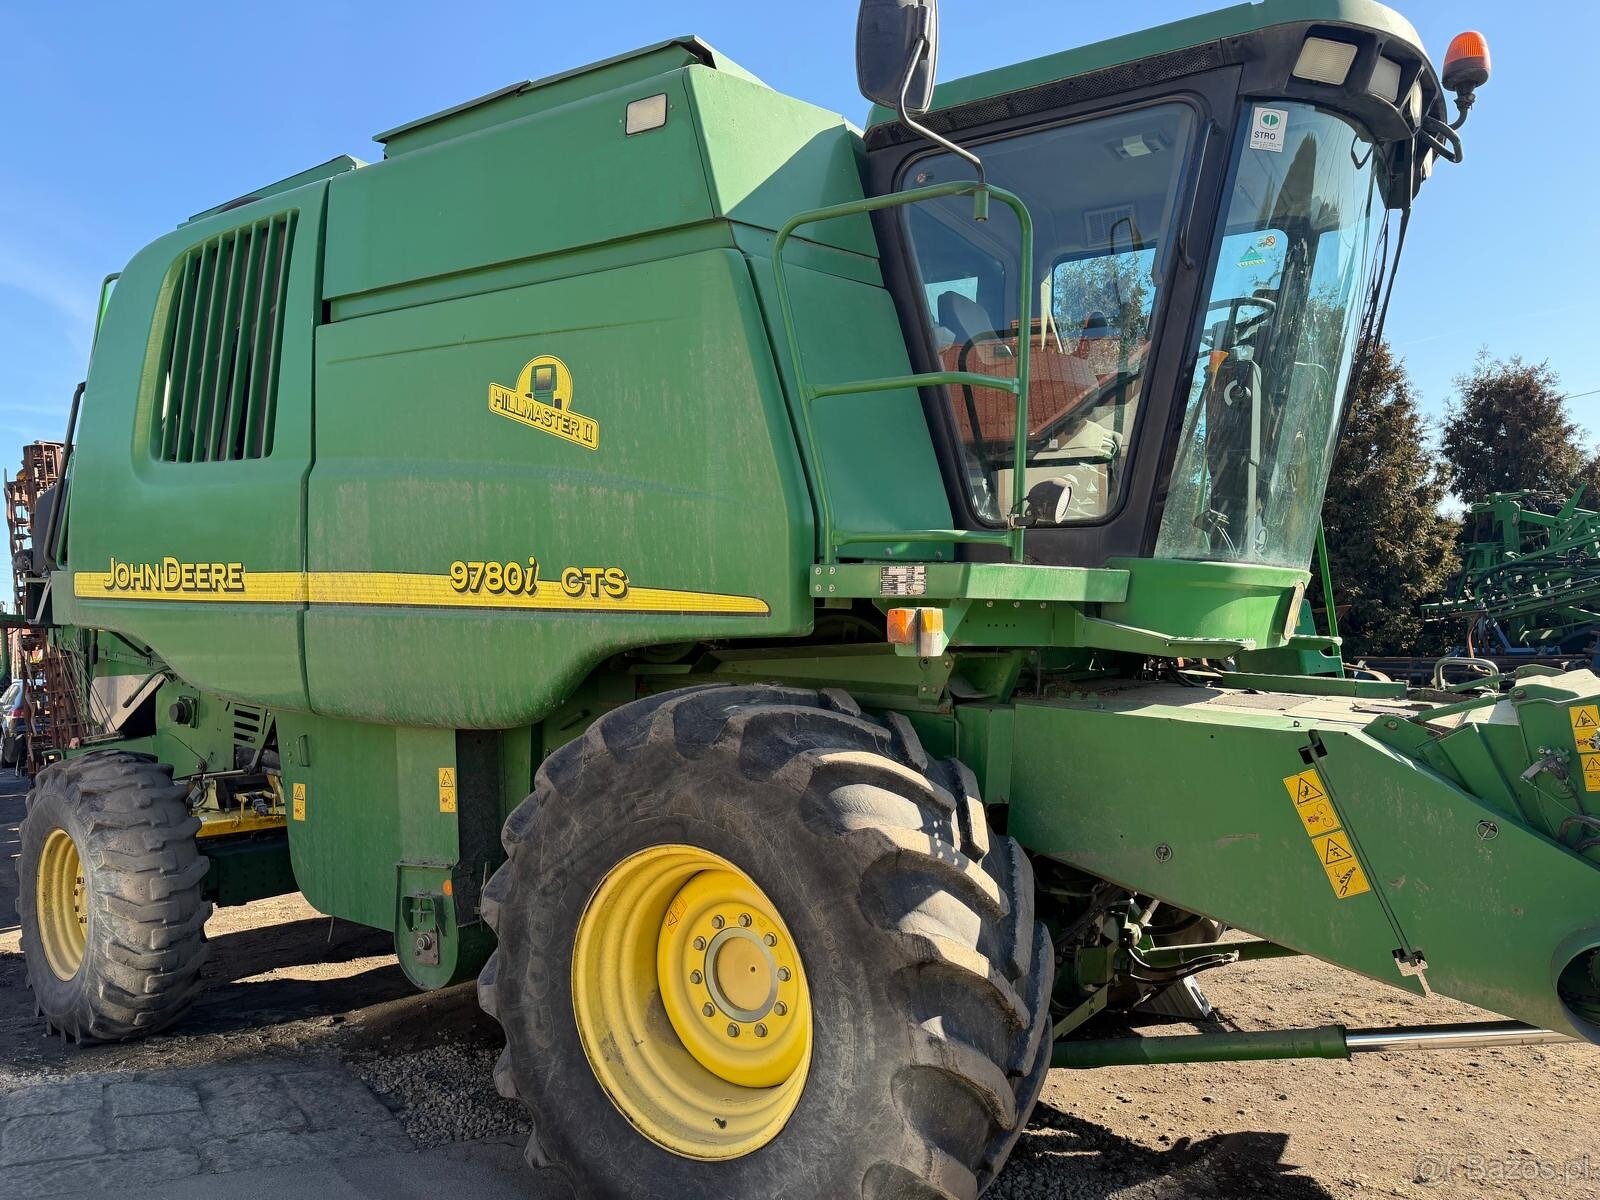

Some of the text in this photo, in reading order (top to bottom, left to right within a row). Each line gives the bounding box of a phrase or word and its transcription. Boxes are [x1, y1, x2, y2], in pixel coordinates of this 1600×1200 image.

[1254, 130, 1276, 140] STRO
[492, 388, 593, 443] HILLMASTER II
[104, 556, 245, 592] JOHN DEERE
[449, 556, 540, 597] 9780i
